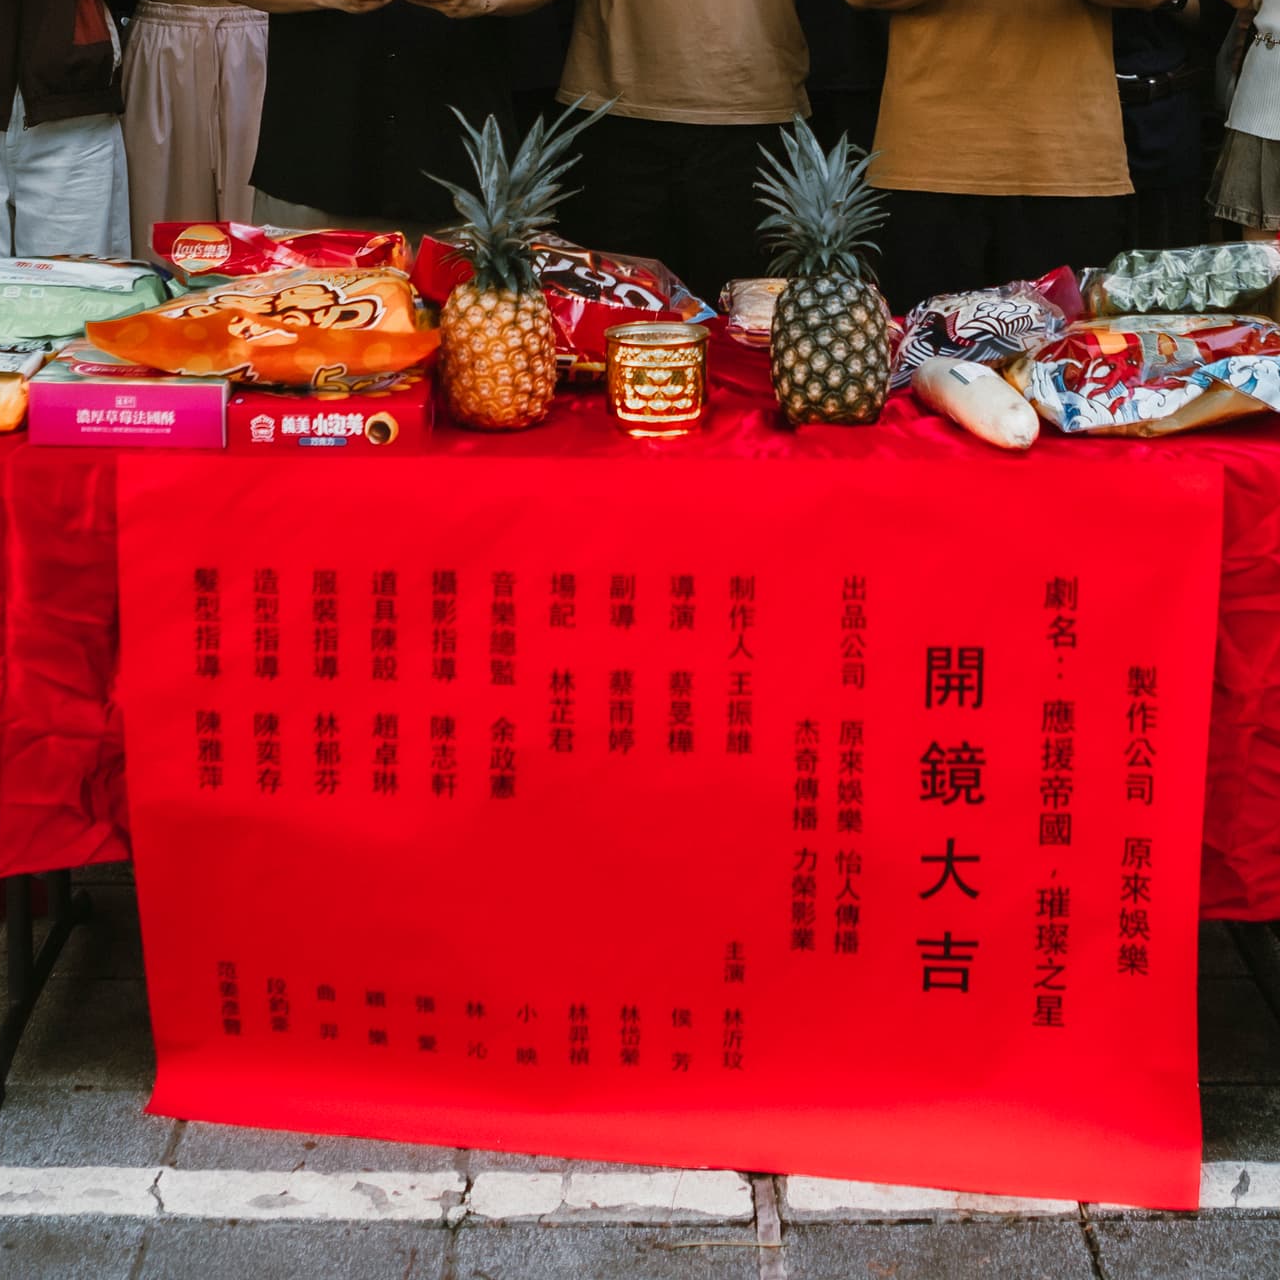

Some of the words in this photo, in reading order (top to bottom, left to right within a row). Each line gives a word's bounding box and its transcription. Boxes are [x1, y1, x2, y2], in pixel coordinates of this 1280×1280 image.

[312, 412, 364, 436] 小泡芙
[254, 568, 279, 681] 造型指導
[312, 570, 339, 682] 服裝指導
[371, 570, 398, 682] 道具陳設
[432, 570, 457, 684] 攝影指導
[490, 571, 516, 686] 音樂總監
[549, 573, 576, 629] 場記
[609, 573, 635, 631] 副導
[669, 575, 696, 632] 導演
[728, 575, 756, 661] 制作人
[840, 575, 867, 690] 出品公司
[254, 713, 282, 795] 陳奕存
[314, 712, 340, 795] 林郁芬
[430, 716, 457, 799] 陳志軒
[793, 720, 820, 832] 杰奇傳播
[837, 720, 865, 834] 原來娛樂
[1124, 666, 1158, 806] 製作公司
[916, 646, 987, 994] 開鏡大吉
[790, 848, 818, 952] 力榮影業
[834, 849, 862, 955] 怡人傳播
[1117, 837, 1152, 976] 原來娛樂
[725, 941, 745, 983] 主演
